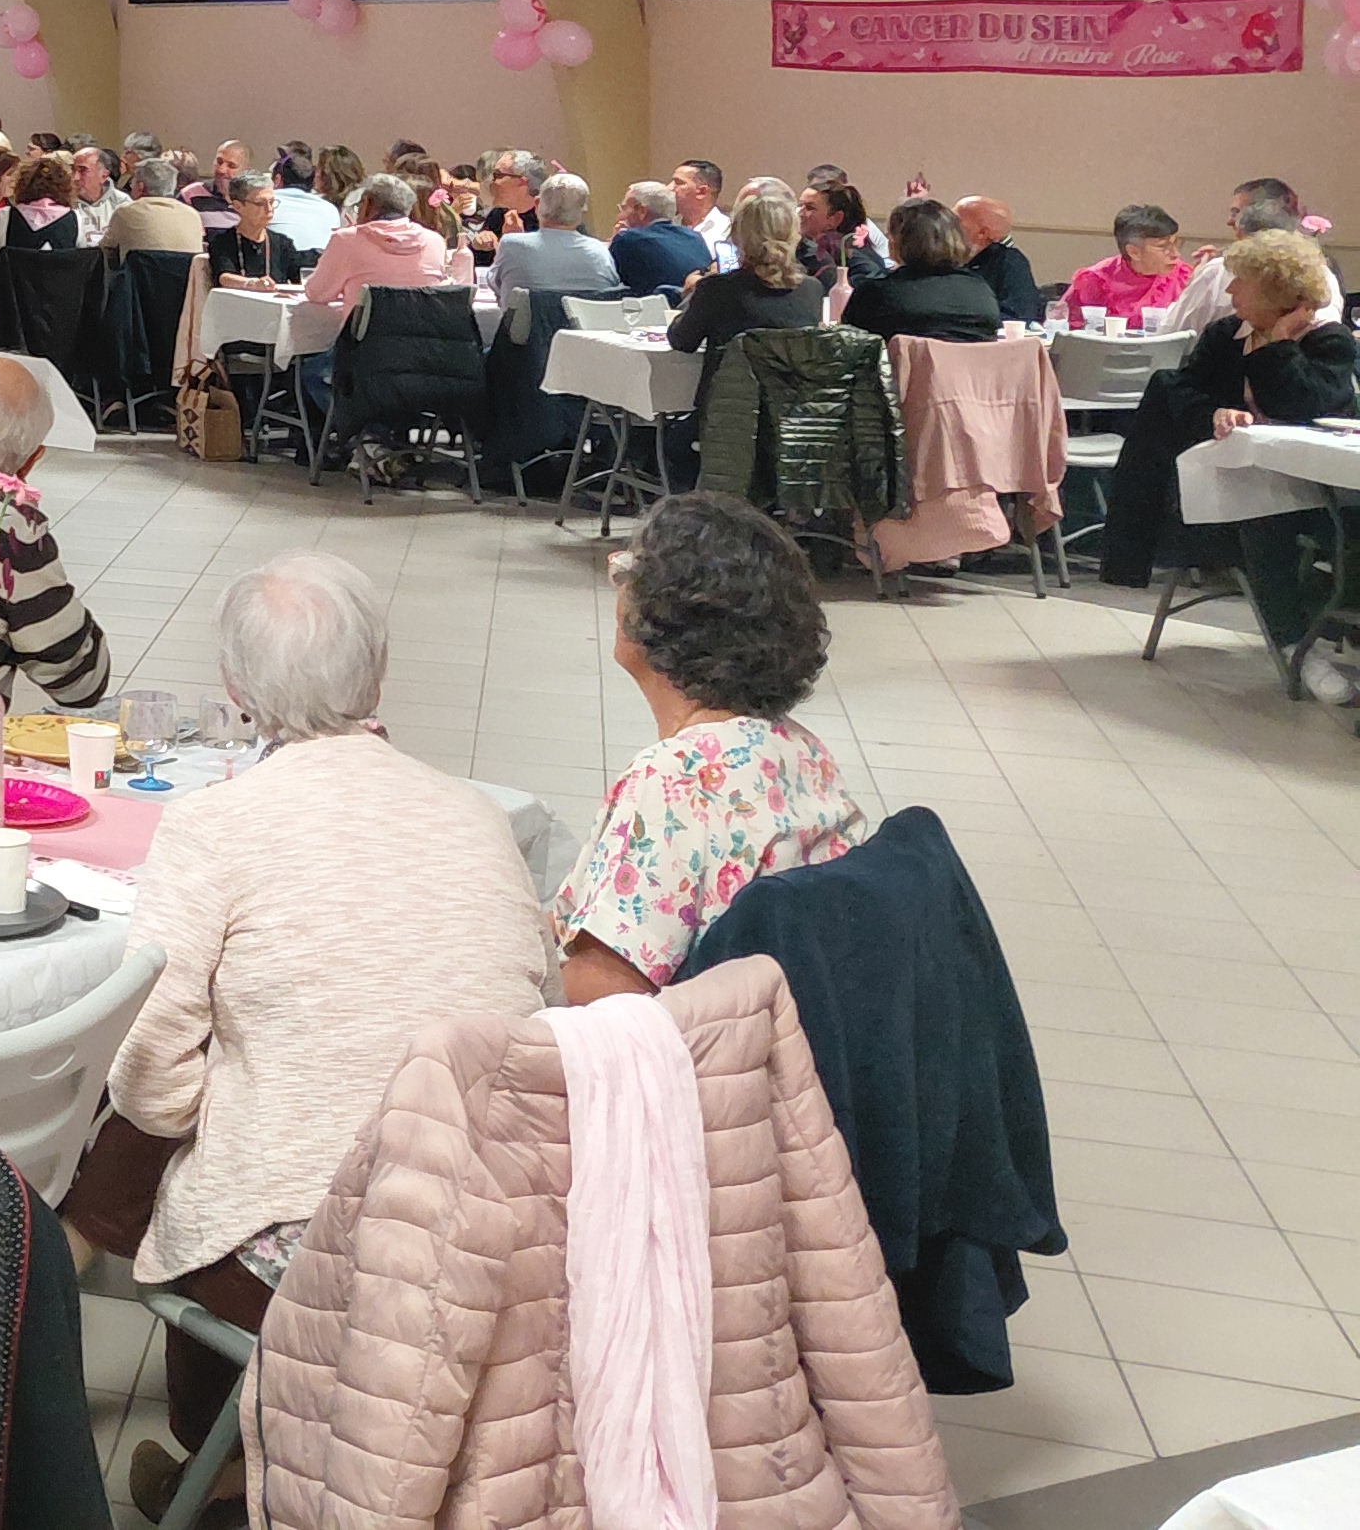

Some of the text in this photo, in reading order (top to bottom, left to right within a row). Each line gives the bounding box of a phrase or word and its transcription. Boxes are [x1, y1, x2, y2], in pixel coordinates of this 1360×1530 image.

[849, 12, 1107, 43] CANCER DU SEIN
